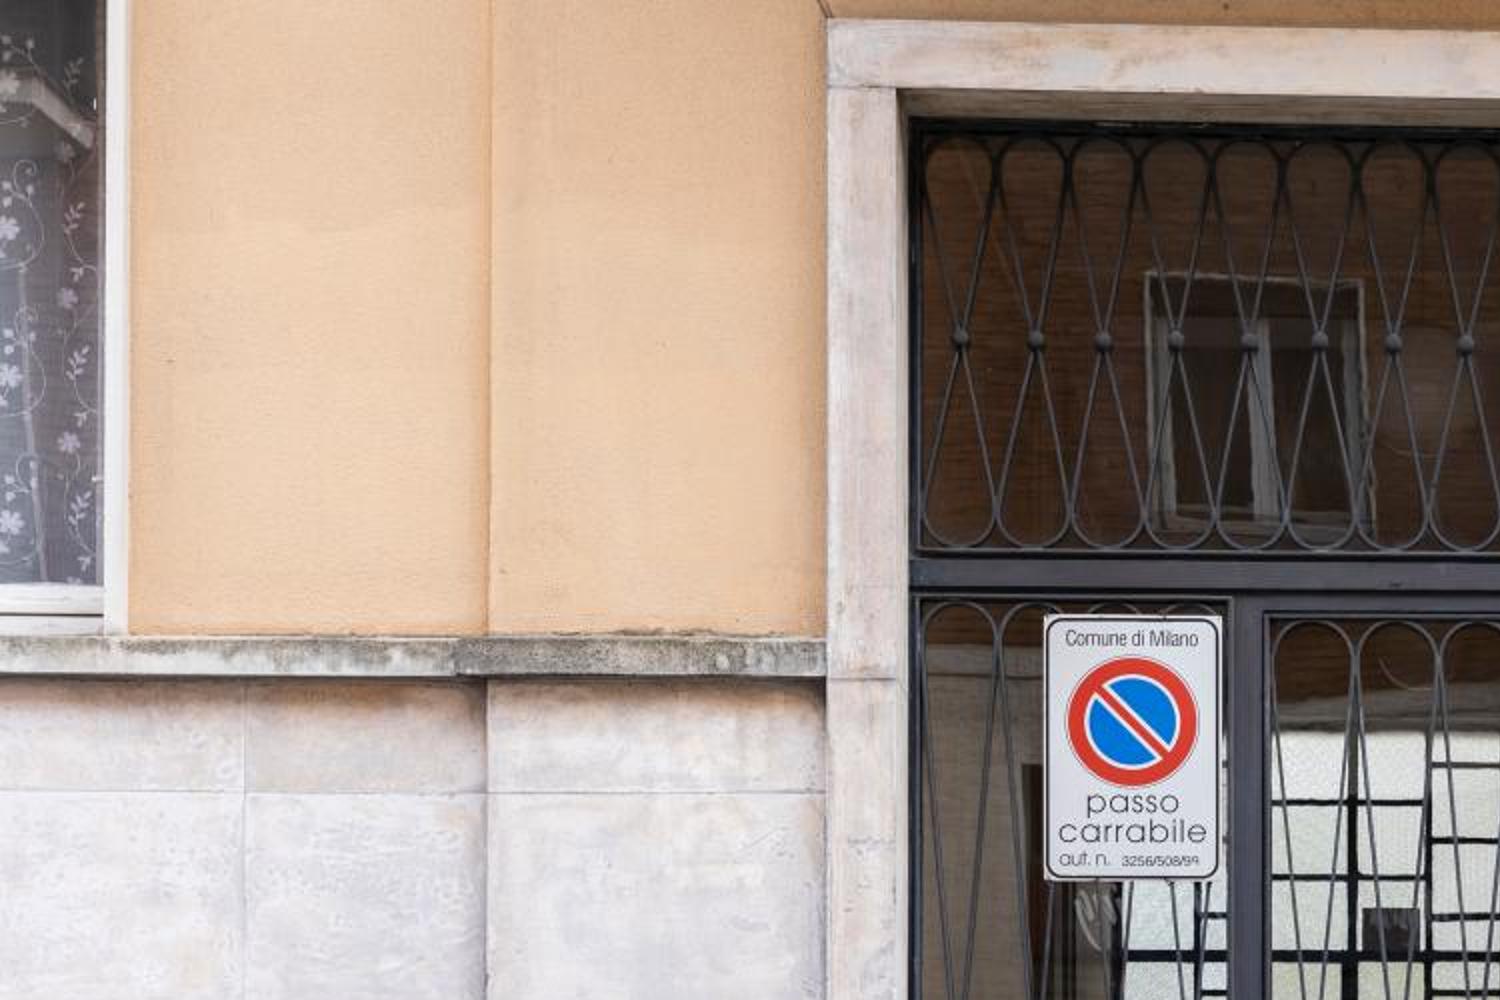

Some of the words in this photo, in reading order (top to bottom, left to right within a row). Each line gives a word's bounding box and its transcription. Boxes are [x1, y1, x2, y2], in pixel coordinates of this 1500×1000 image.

[1065, 630, 1128, 648] Comune
[1131, 630, 1145, 647] di
[1149, 630, 1199, 648] Milano
[1087, 792, 1180, 818] passo
[1059, 818, 1207, 844] carrabile
[1059, 850, 1092, 867] aut.
[1095, 853, 1112, 866] n.
